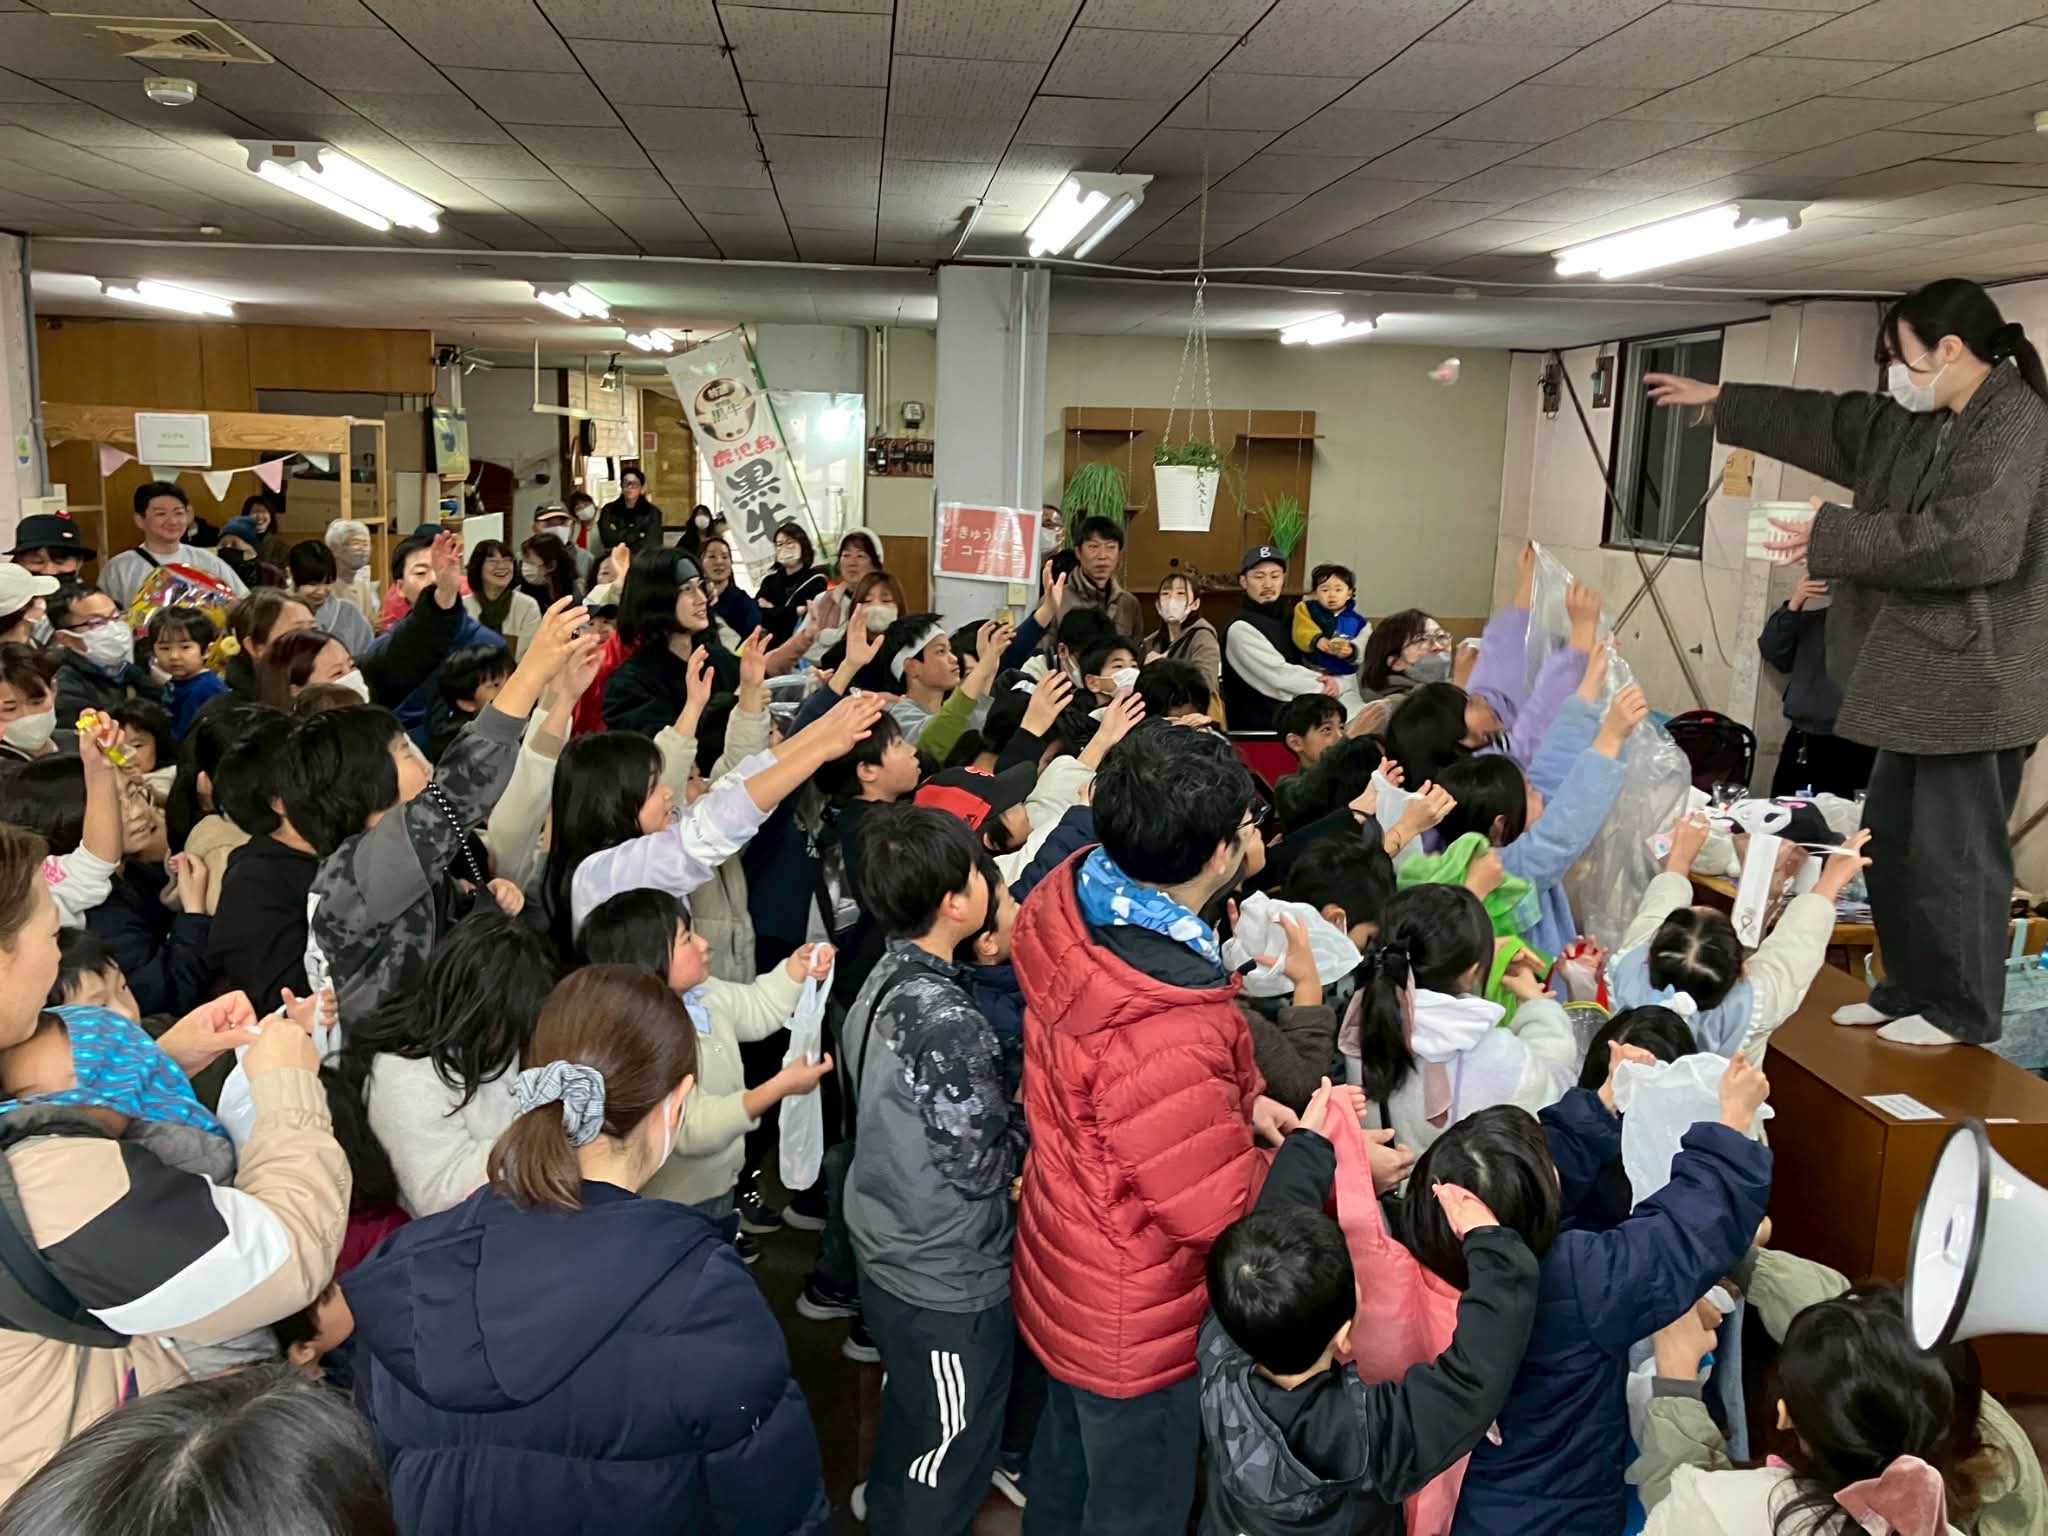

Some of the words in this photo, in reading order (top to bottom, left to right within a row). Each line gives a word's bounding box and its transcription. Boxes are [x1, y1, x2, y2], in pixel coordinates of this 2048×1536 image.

[712, 435, 776, 468] 鹿児島
[726, 458, 797, 543] 黒牛
